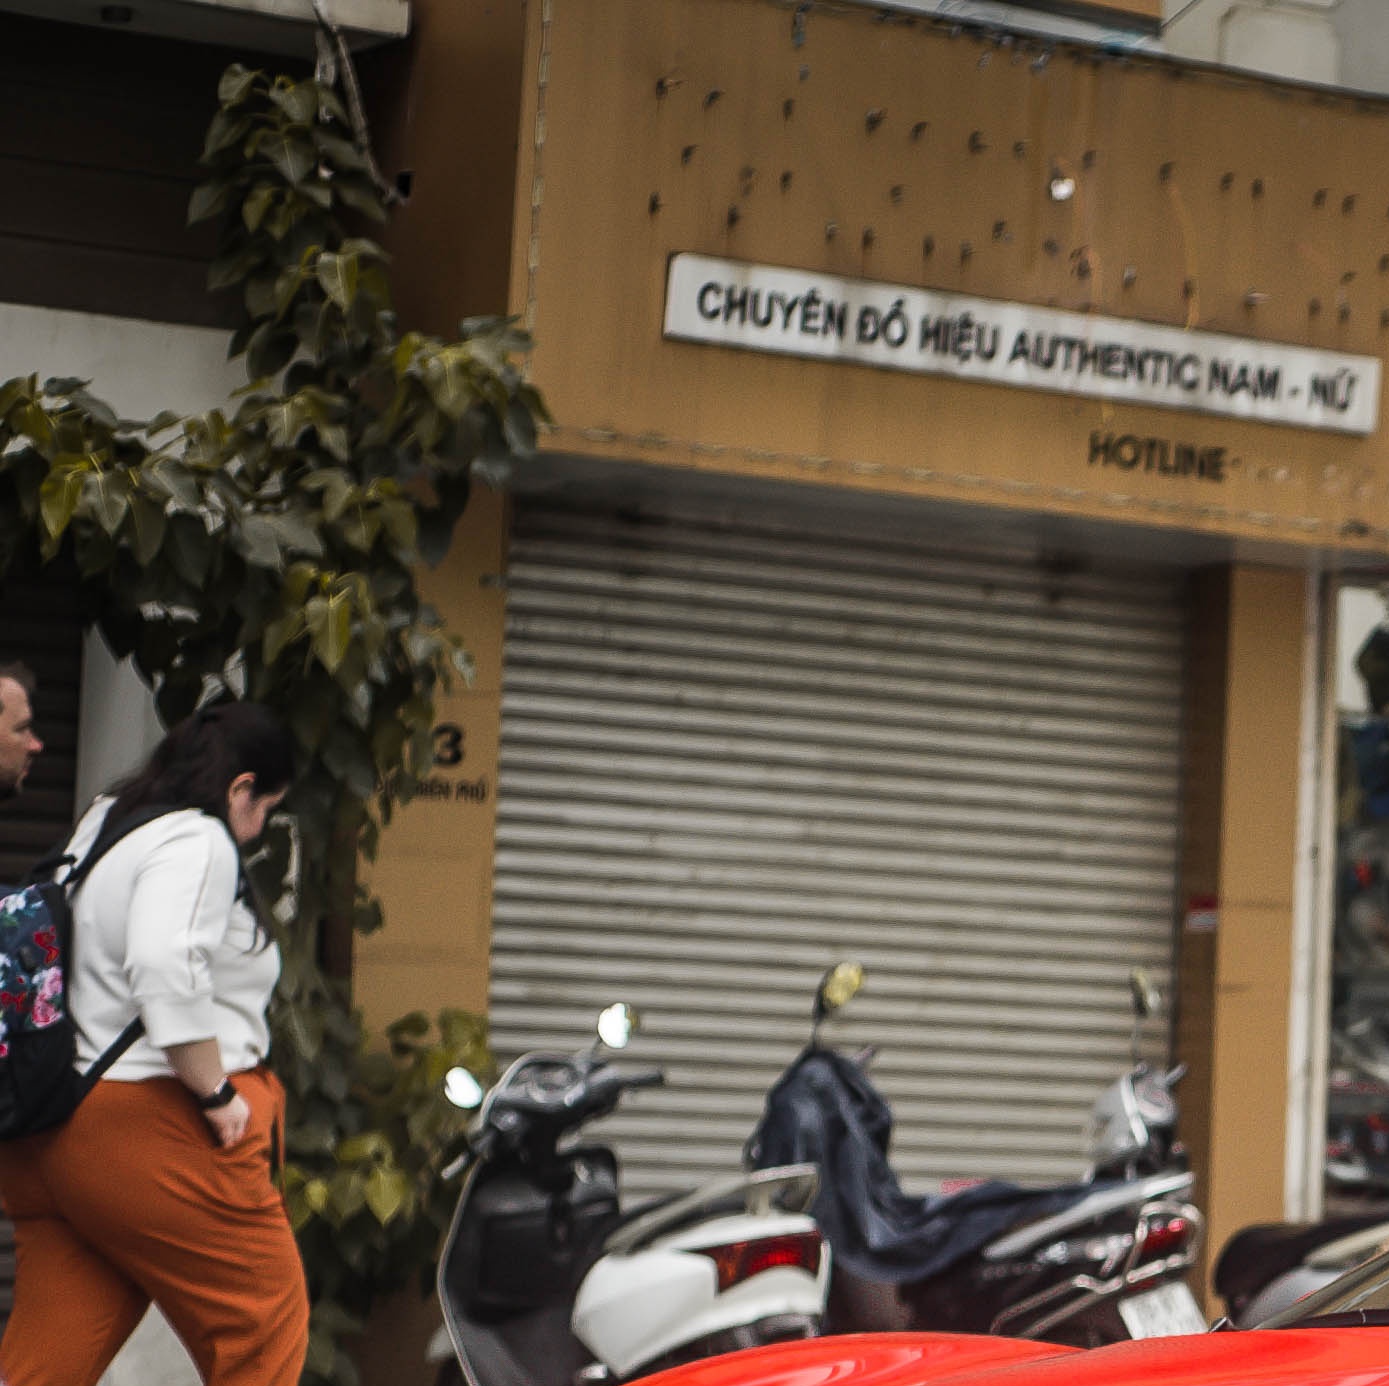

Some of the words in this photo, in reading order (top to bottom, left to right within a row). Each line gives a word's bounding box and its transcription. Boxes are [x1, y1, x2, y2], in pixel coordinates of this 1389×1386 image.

[697, 282, 847, 342] CHUYÊN
[1008, 328, 1200, 393] AUTHENTIC
[1207, 356, 1282, 402] NAM
